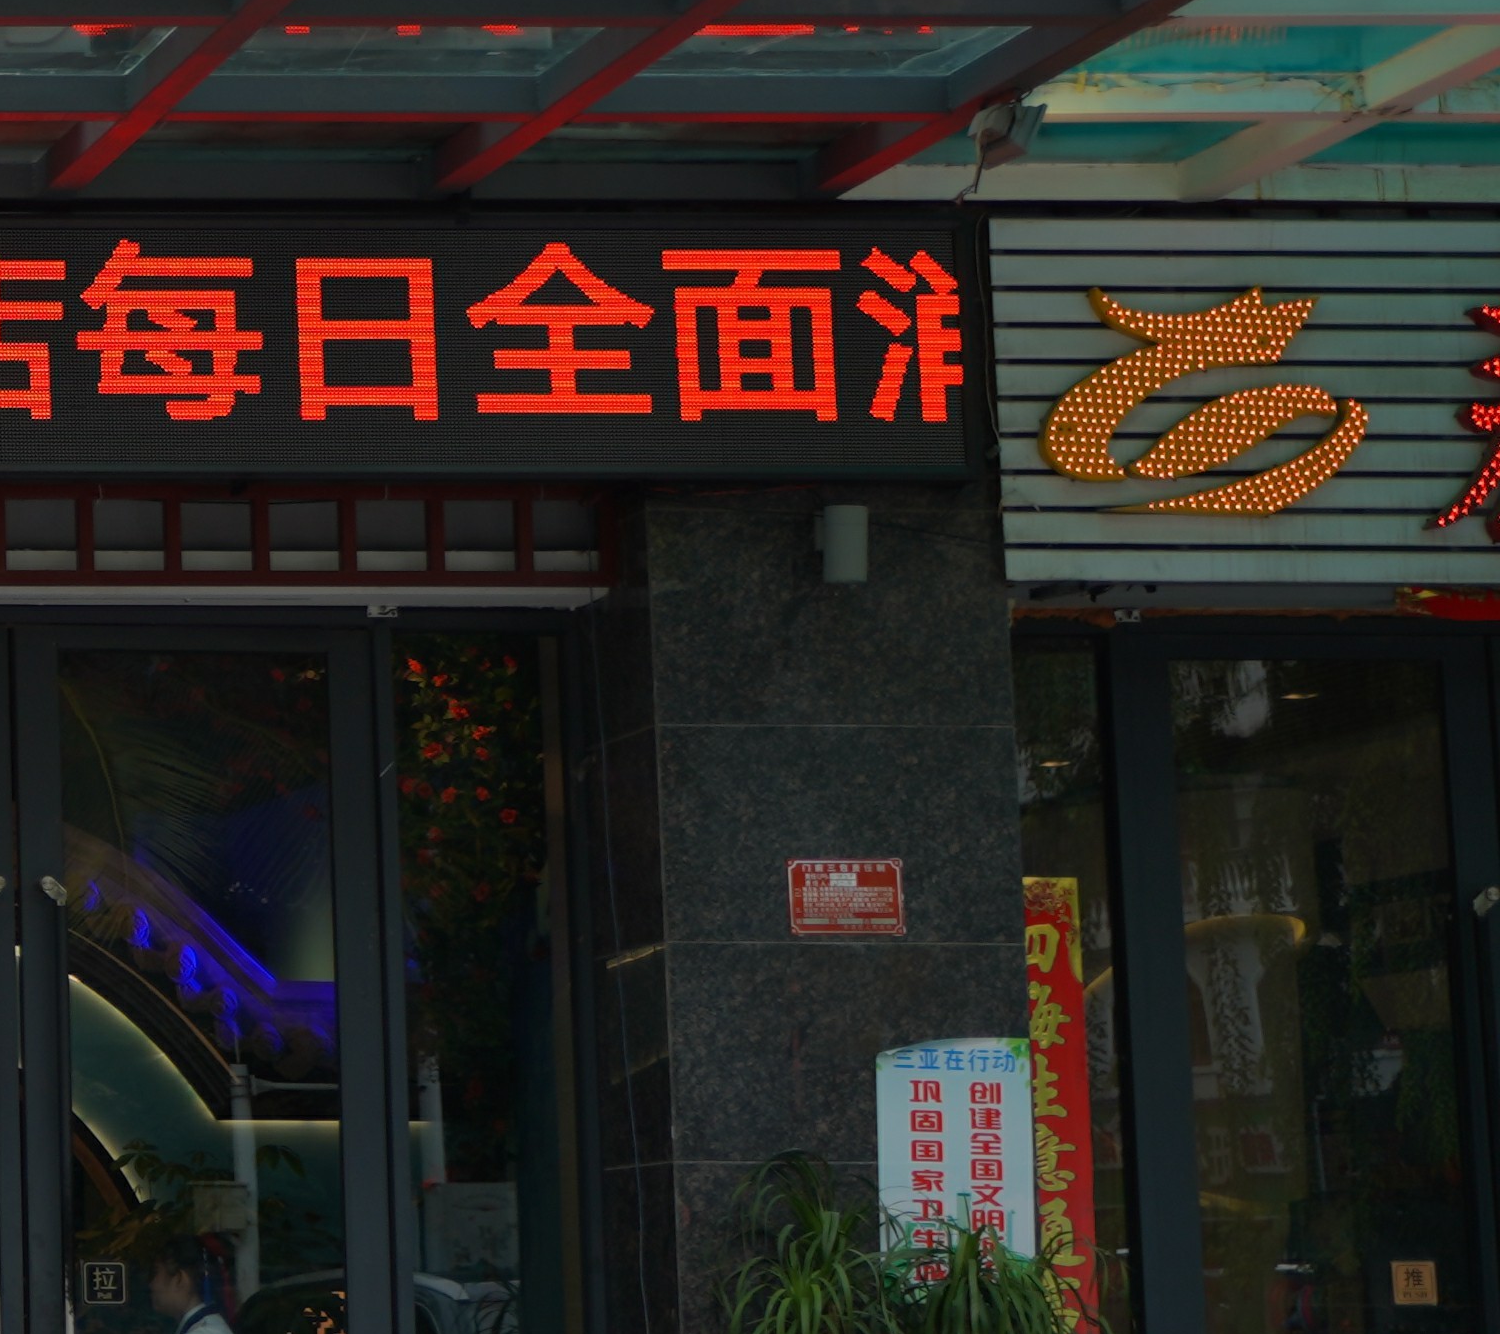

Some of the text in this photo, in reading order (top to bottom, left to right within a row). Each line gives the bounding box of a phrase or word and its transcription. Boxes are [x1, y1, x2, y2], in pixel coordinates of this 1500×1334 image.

[893, 1047, 1017, 1073] 三亚在行动
[968, 1080, 1006, 1282] 创建全国文明
[92, 1267, 117, 1291] 拉
[1403, 1267, 1425, 1288] 推
